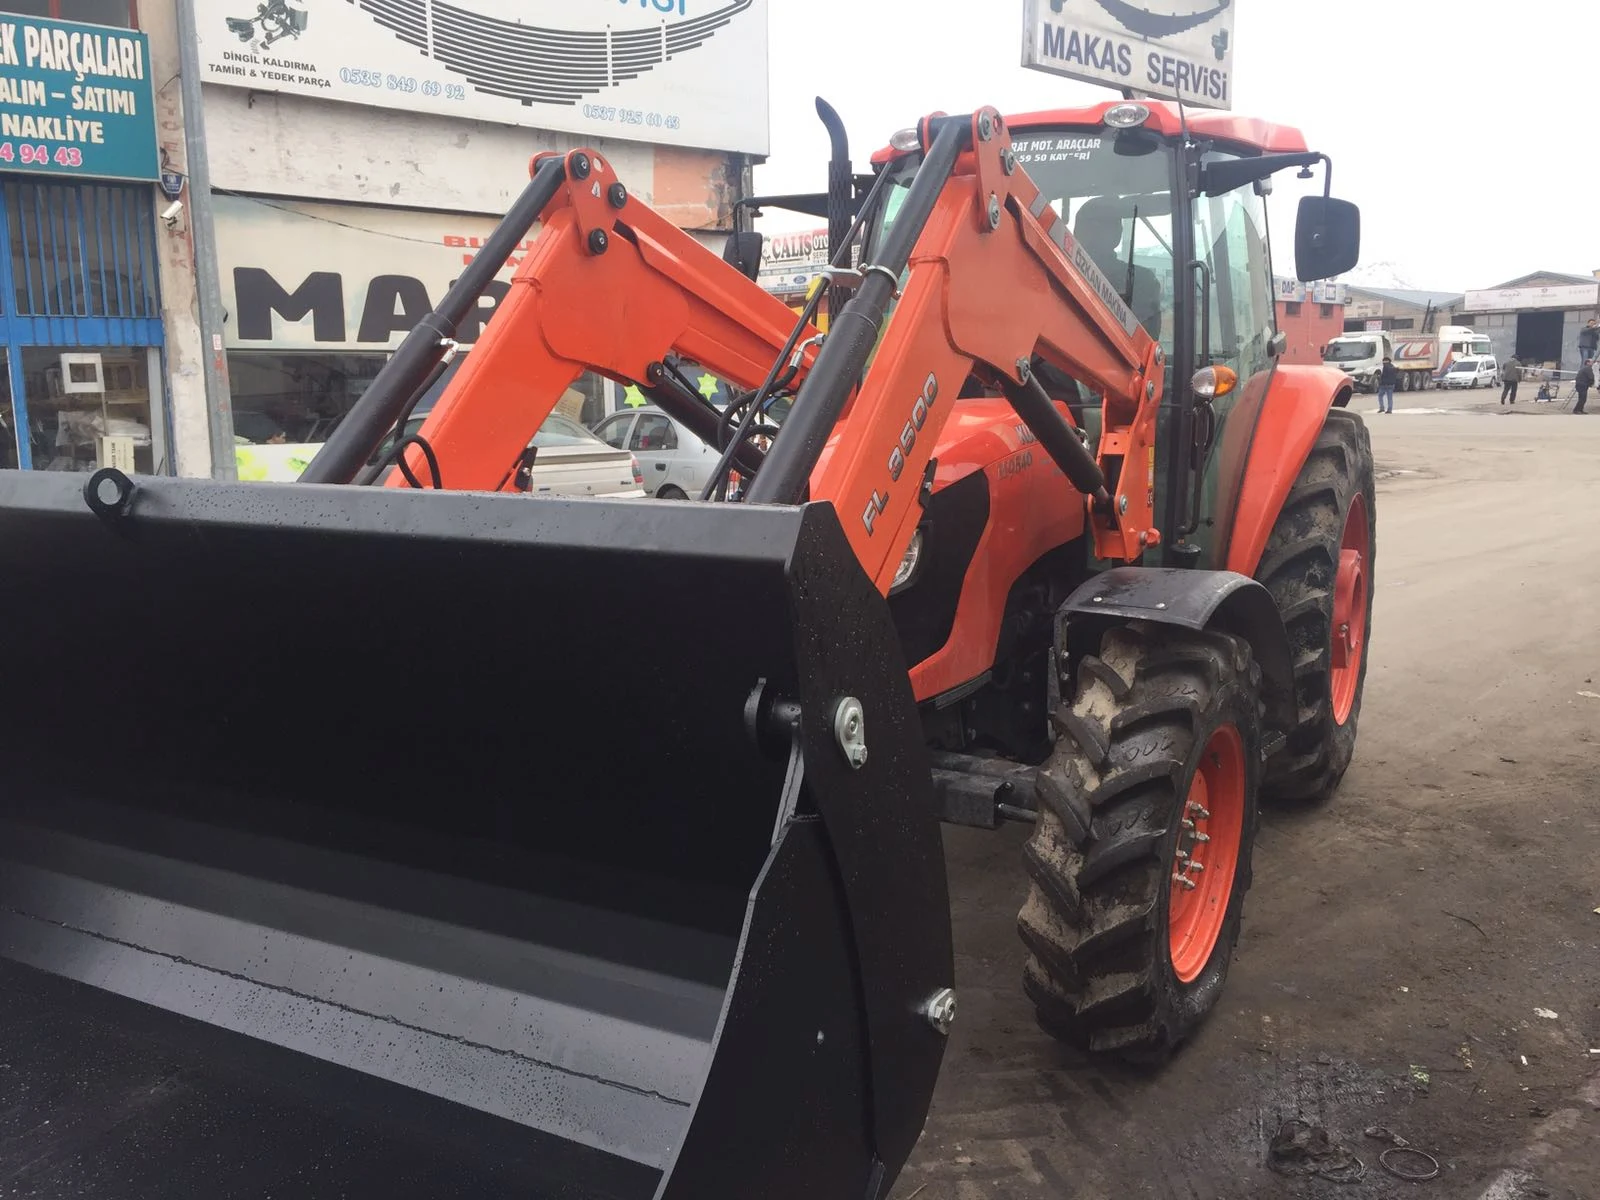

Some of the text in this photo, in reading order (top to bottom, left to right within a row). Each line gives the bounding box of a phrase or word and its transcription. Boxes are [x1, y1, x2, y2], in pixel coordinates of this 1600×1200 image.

[0, 23, 144, 82] K PARÇALARI
[223, 51, 317, 73] DİNGİL KALDIRMA
[1043, 22, 1132, 76] MAKAS
[208, 63, 332, 88] TAMİRİ & YEDEK PARÇA
[339, 67, 465, 100] 0535 849 69 92
[0, 77, 46, 107] ALIM
[71, 85, 136, 115] SATIMI
[2, 113, 105, 144] NAKLİYE
[19, 144, 49, 165] 94
[54, 147, 82, 166] 43
[1034, 153, 1047, 162] 50
[1056, 138, 1101, 151] ARAÇLAR
[862, 371, 939, 537] FL 3500
